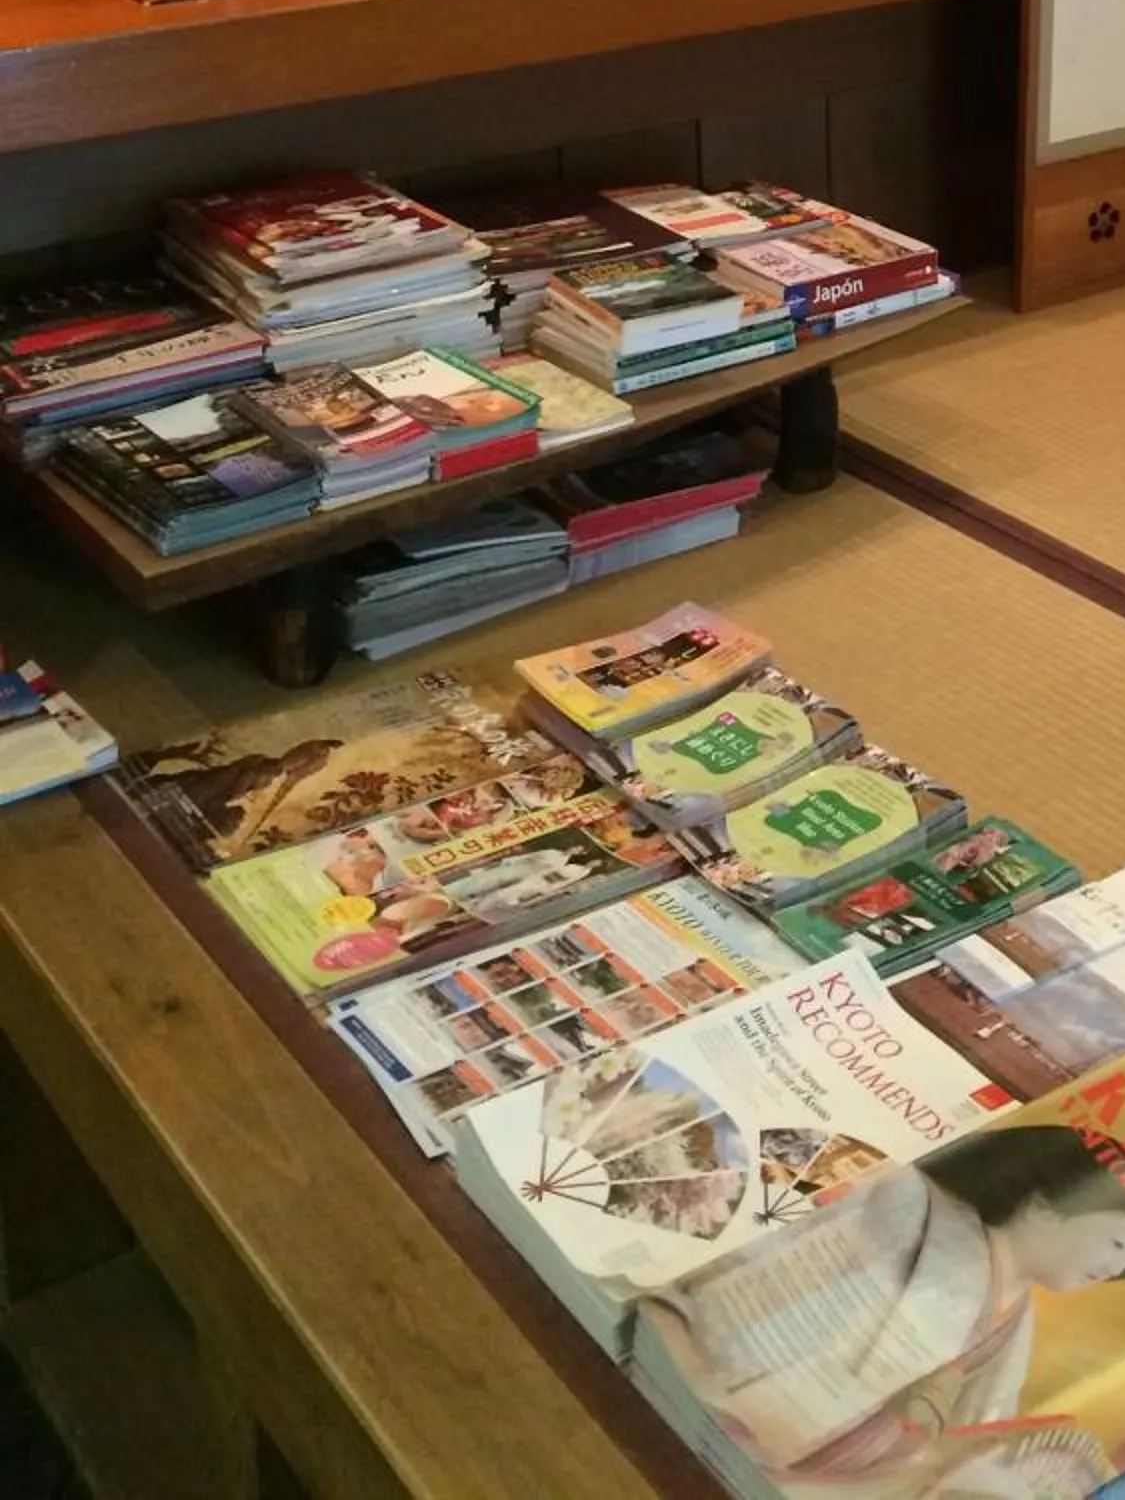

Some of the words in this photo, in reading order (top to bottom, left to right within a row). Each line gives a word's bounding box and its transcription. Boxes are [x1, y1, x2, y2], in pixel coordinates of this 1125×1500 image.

[812, 276, 864, 304] Japón
[817, 970, 904, 1060] KYOTO
[786, 985, 956, 1142] RECOMMENDS
